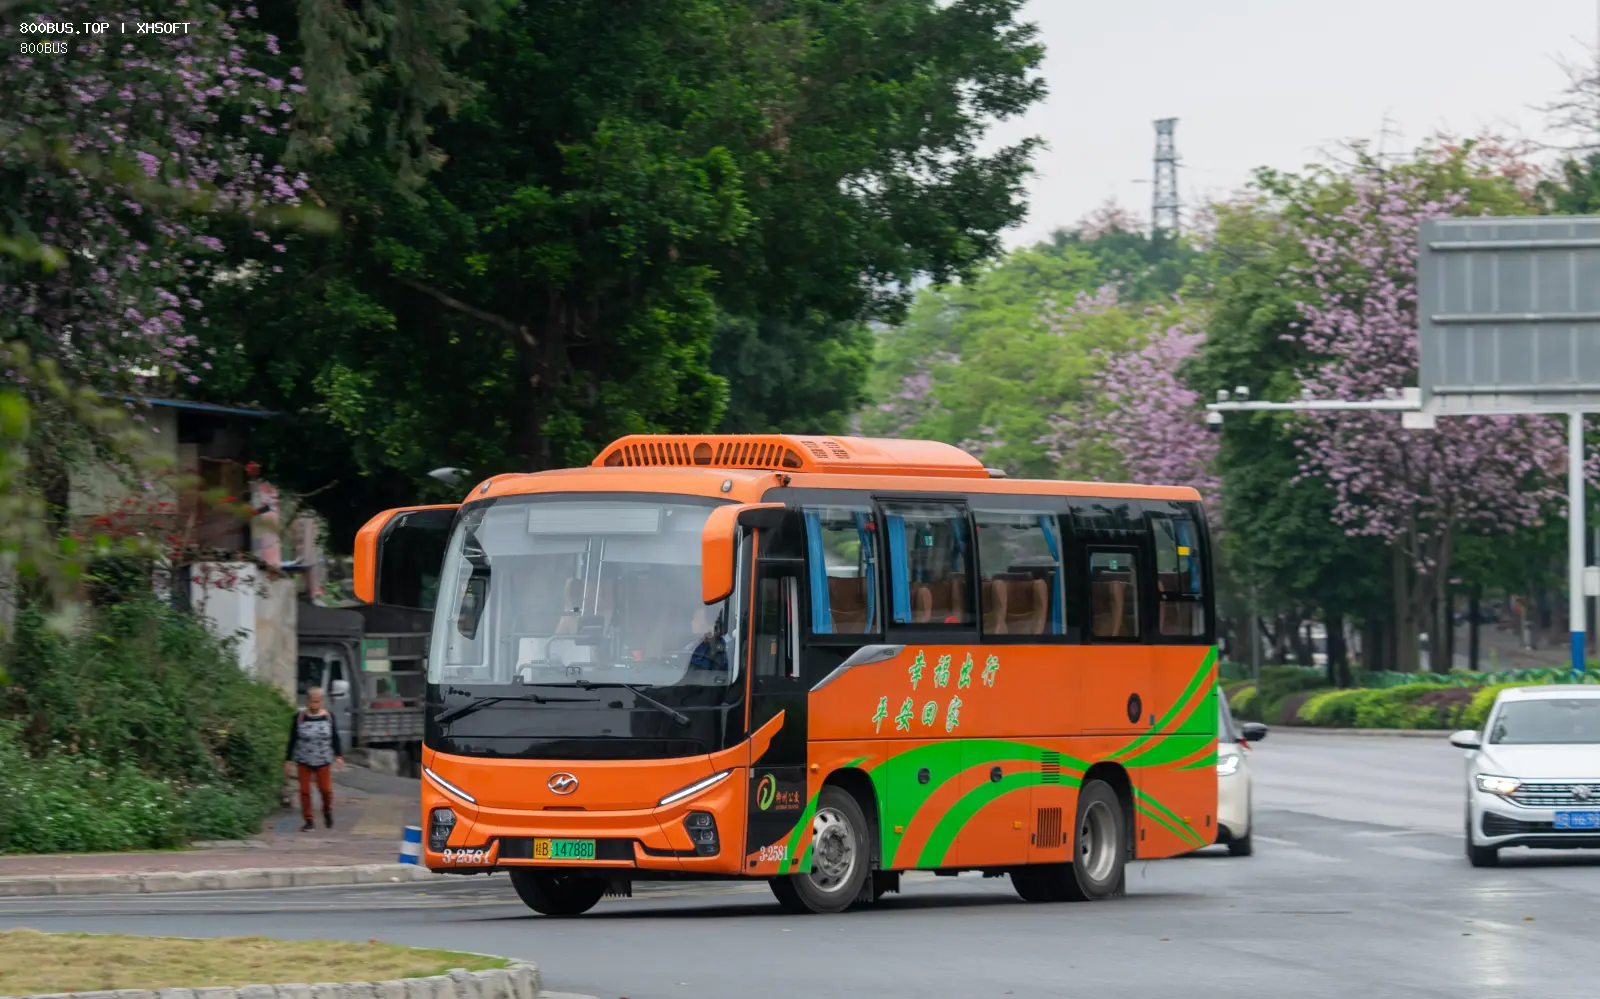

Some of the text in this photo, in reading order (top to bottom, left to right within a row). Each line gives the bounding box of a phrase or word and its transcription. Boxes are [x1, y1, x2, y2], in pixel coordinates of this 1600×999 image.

[908, 650, 999, 690] 幸福出行
[872, 694, 962, 734] 平安回家
[442, 848, 491, 864] 3-2581
[555, 841, 594, 857] 14788D
[759, 845, 788, 862] 3-2581
